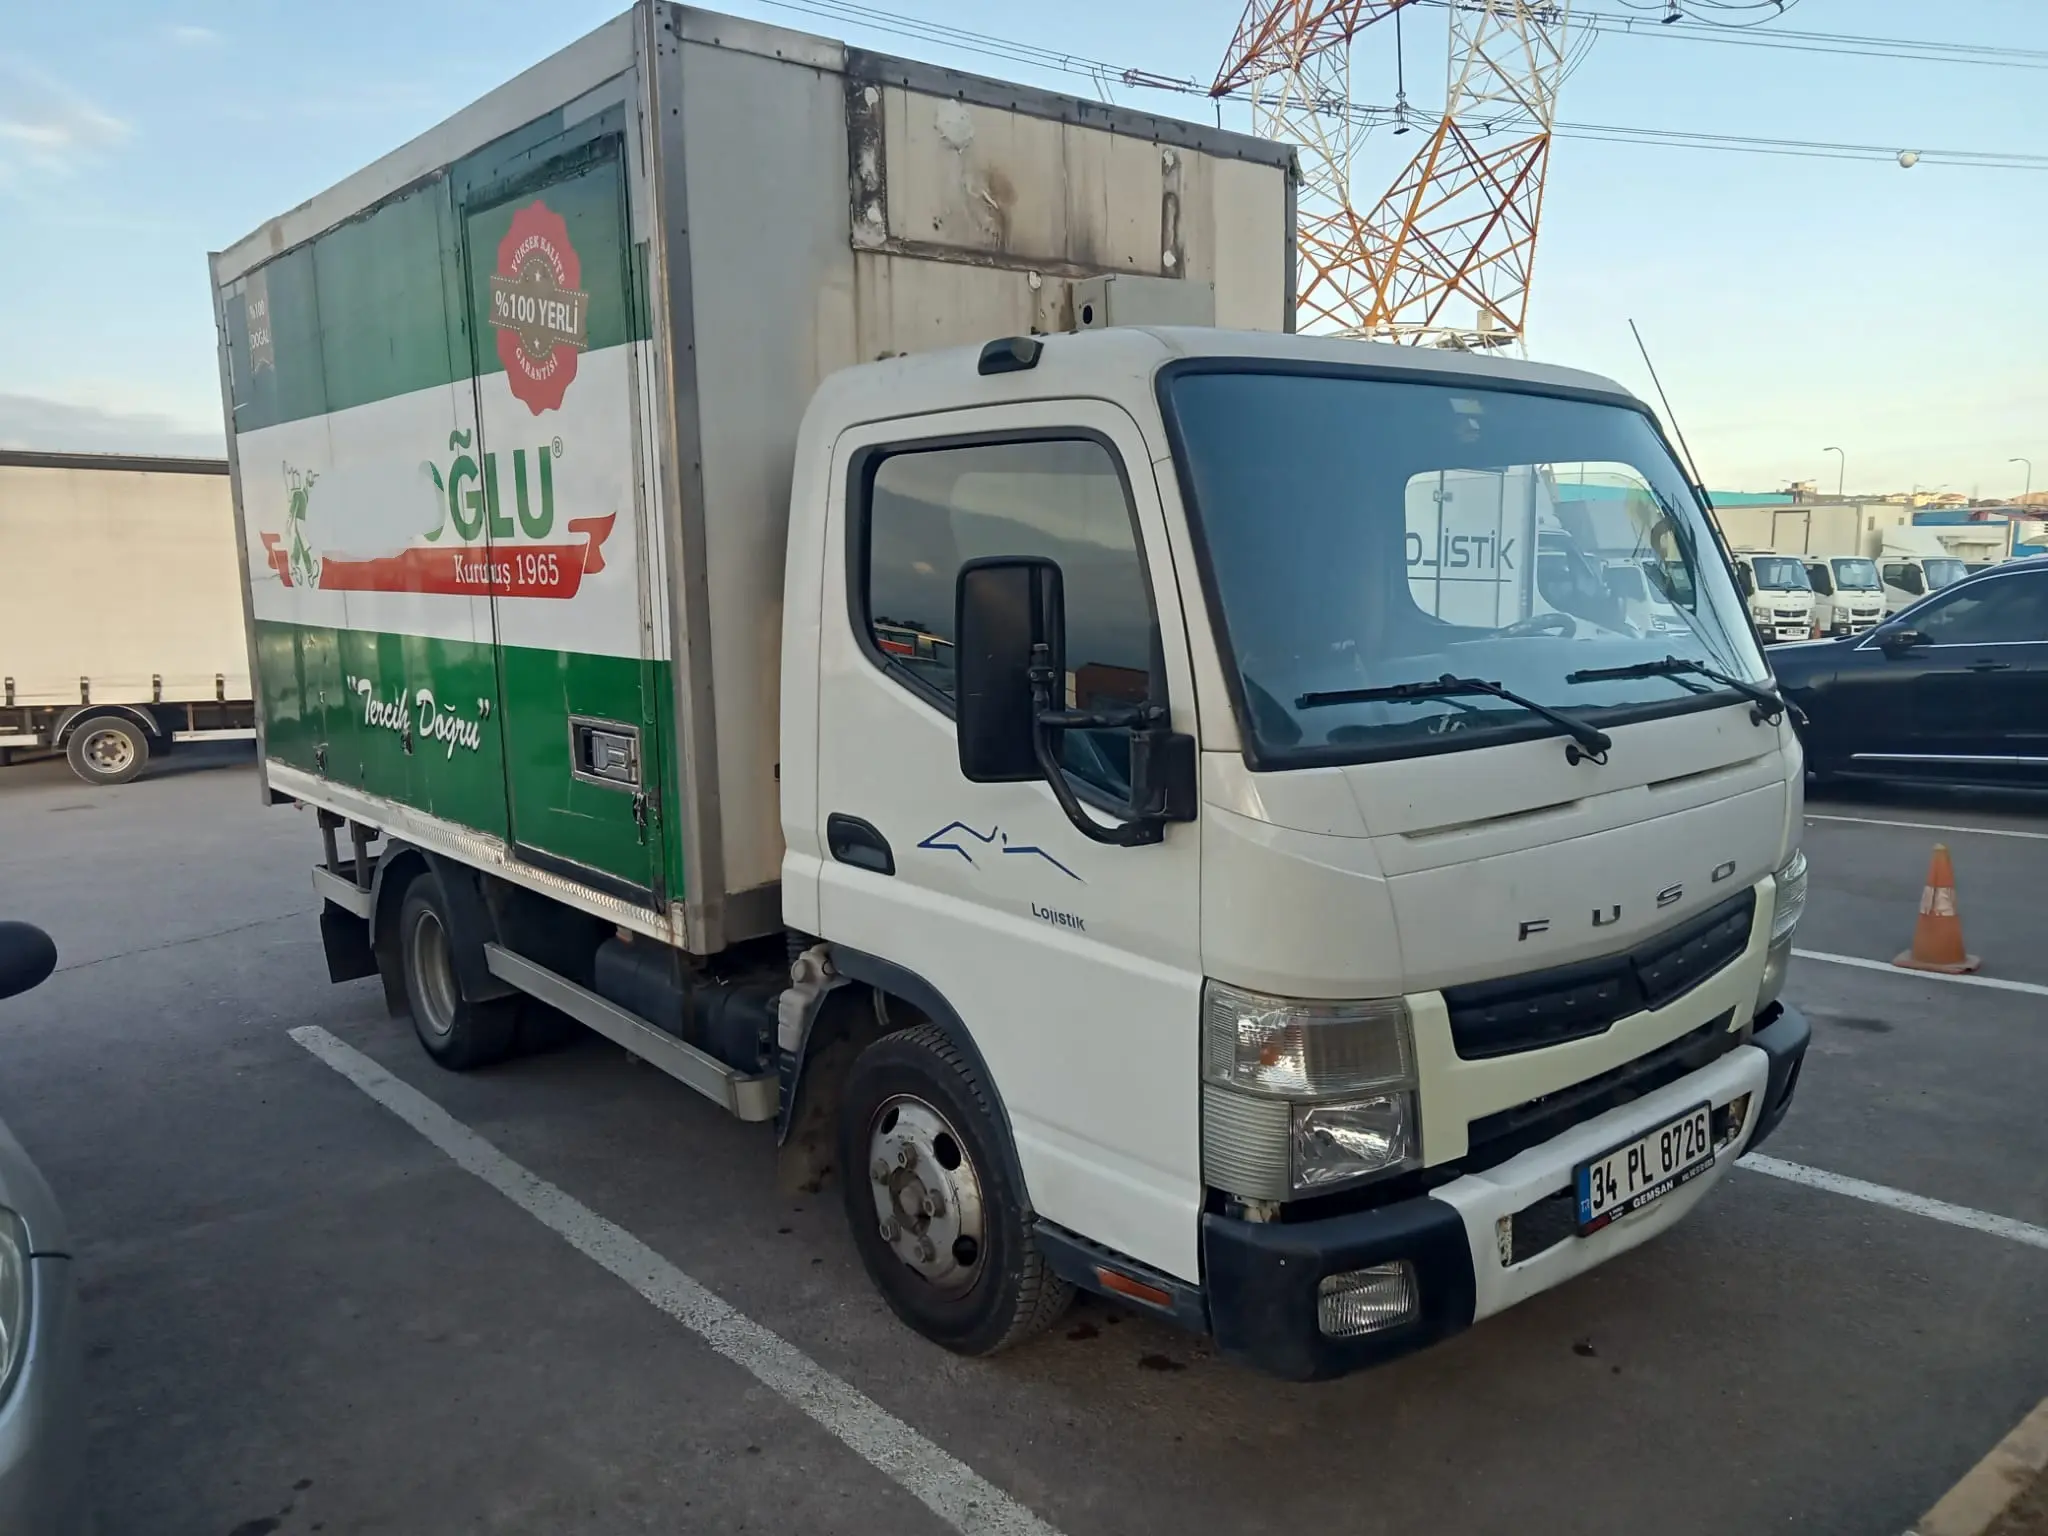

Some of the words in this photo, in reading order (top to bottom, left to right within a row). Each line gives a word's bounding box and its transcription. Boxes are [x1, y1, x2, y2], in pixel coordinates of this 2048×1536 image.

[495, 290, 535, 324] %100
[539, 299, 578, 335] YERLİ
[516, 553, 560, 585] 1965
[1031, 902, 1086, 932] Lojistik
[1518, 860, 1736, 942] FUSO
[1592, 1161, 1617, 1210] 34
[1628, 1144, 1654, 1192] PL
[1660, 1113, 1706, 1172] 8726
[1580, 1198, 1590, 1213] TR
[1632, 1180, 1674, 1209] GEMSAN
